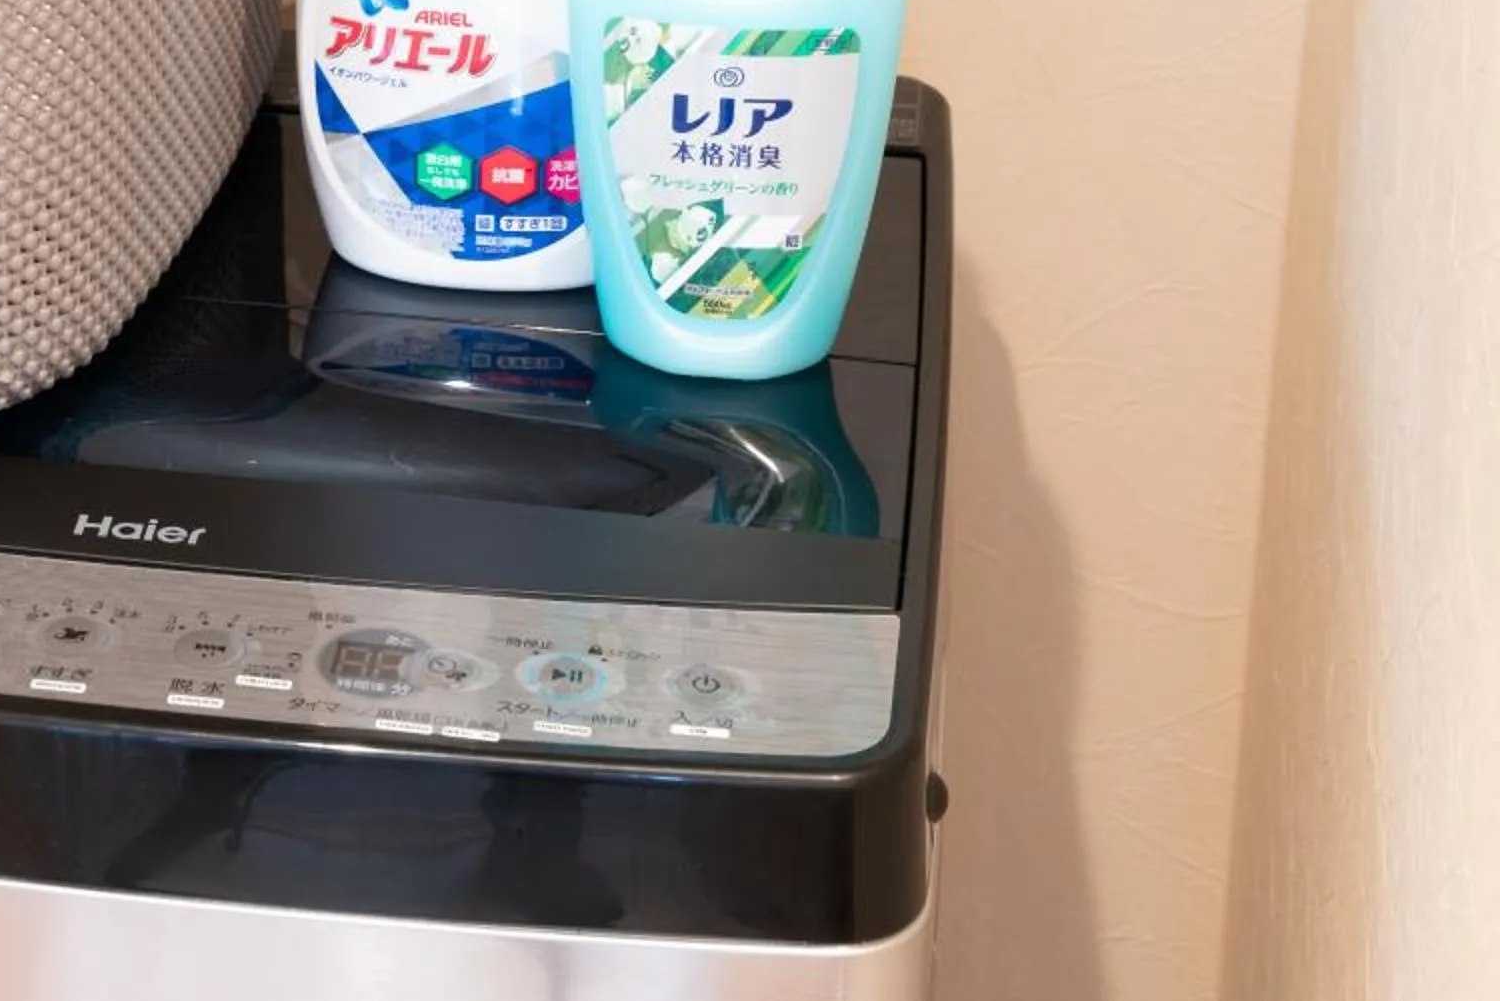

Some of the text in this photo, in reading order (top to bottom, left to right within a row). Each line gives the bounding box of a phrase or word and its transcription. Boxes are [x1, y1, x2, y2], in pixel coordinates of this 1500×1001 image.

[414, 10, 473, 27] ARIEL
[326, 16, 498, 77] アリエール
[672, 93, 793, 138] レノア
[670, 140, 782, 170] 本格消臭
[649, 173, 799, 196] フレッシュグリーンの香り
[73, 513, 207, 545] Haier
